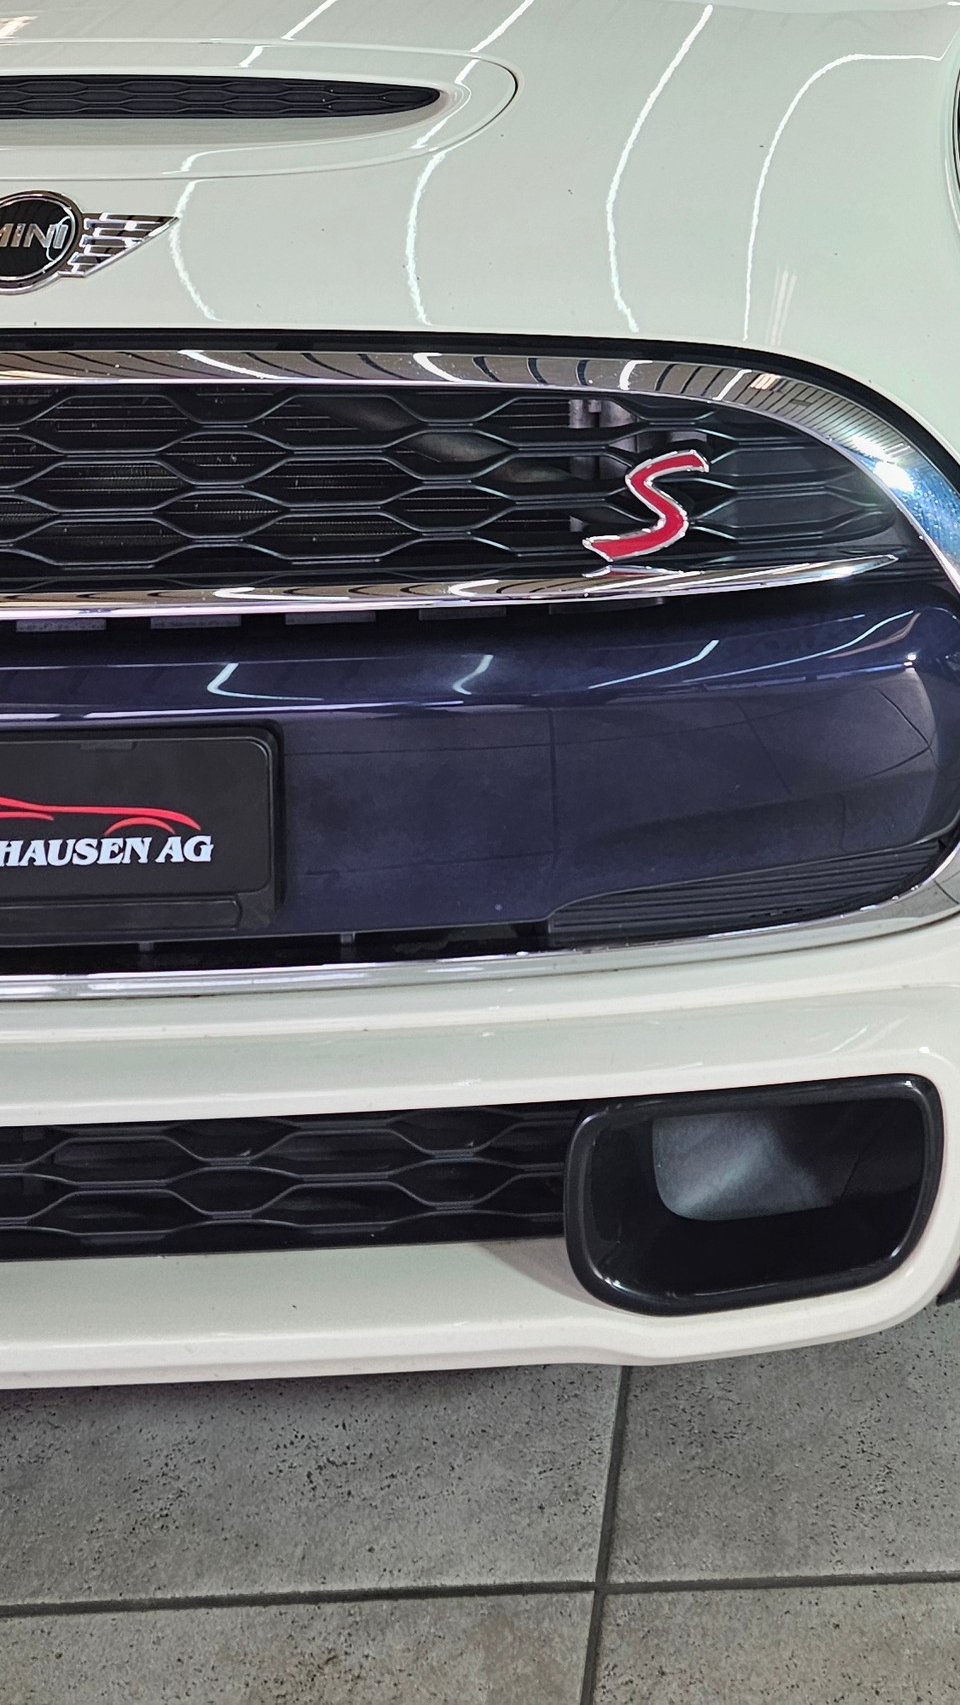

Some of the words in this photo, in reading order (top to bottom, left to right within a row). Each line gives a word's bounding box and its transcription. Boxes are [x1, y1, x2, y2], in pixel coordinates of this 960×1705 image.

[582, 449, 709, 562] S
[0, 836, 152, 867] HAUSEN
[155, 835, 214, 863] AG
